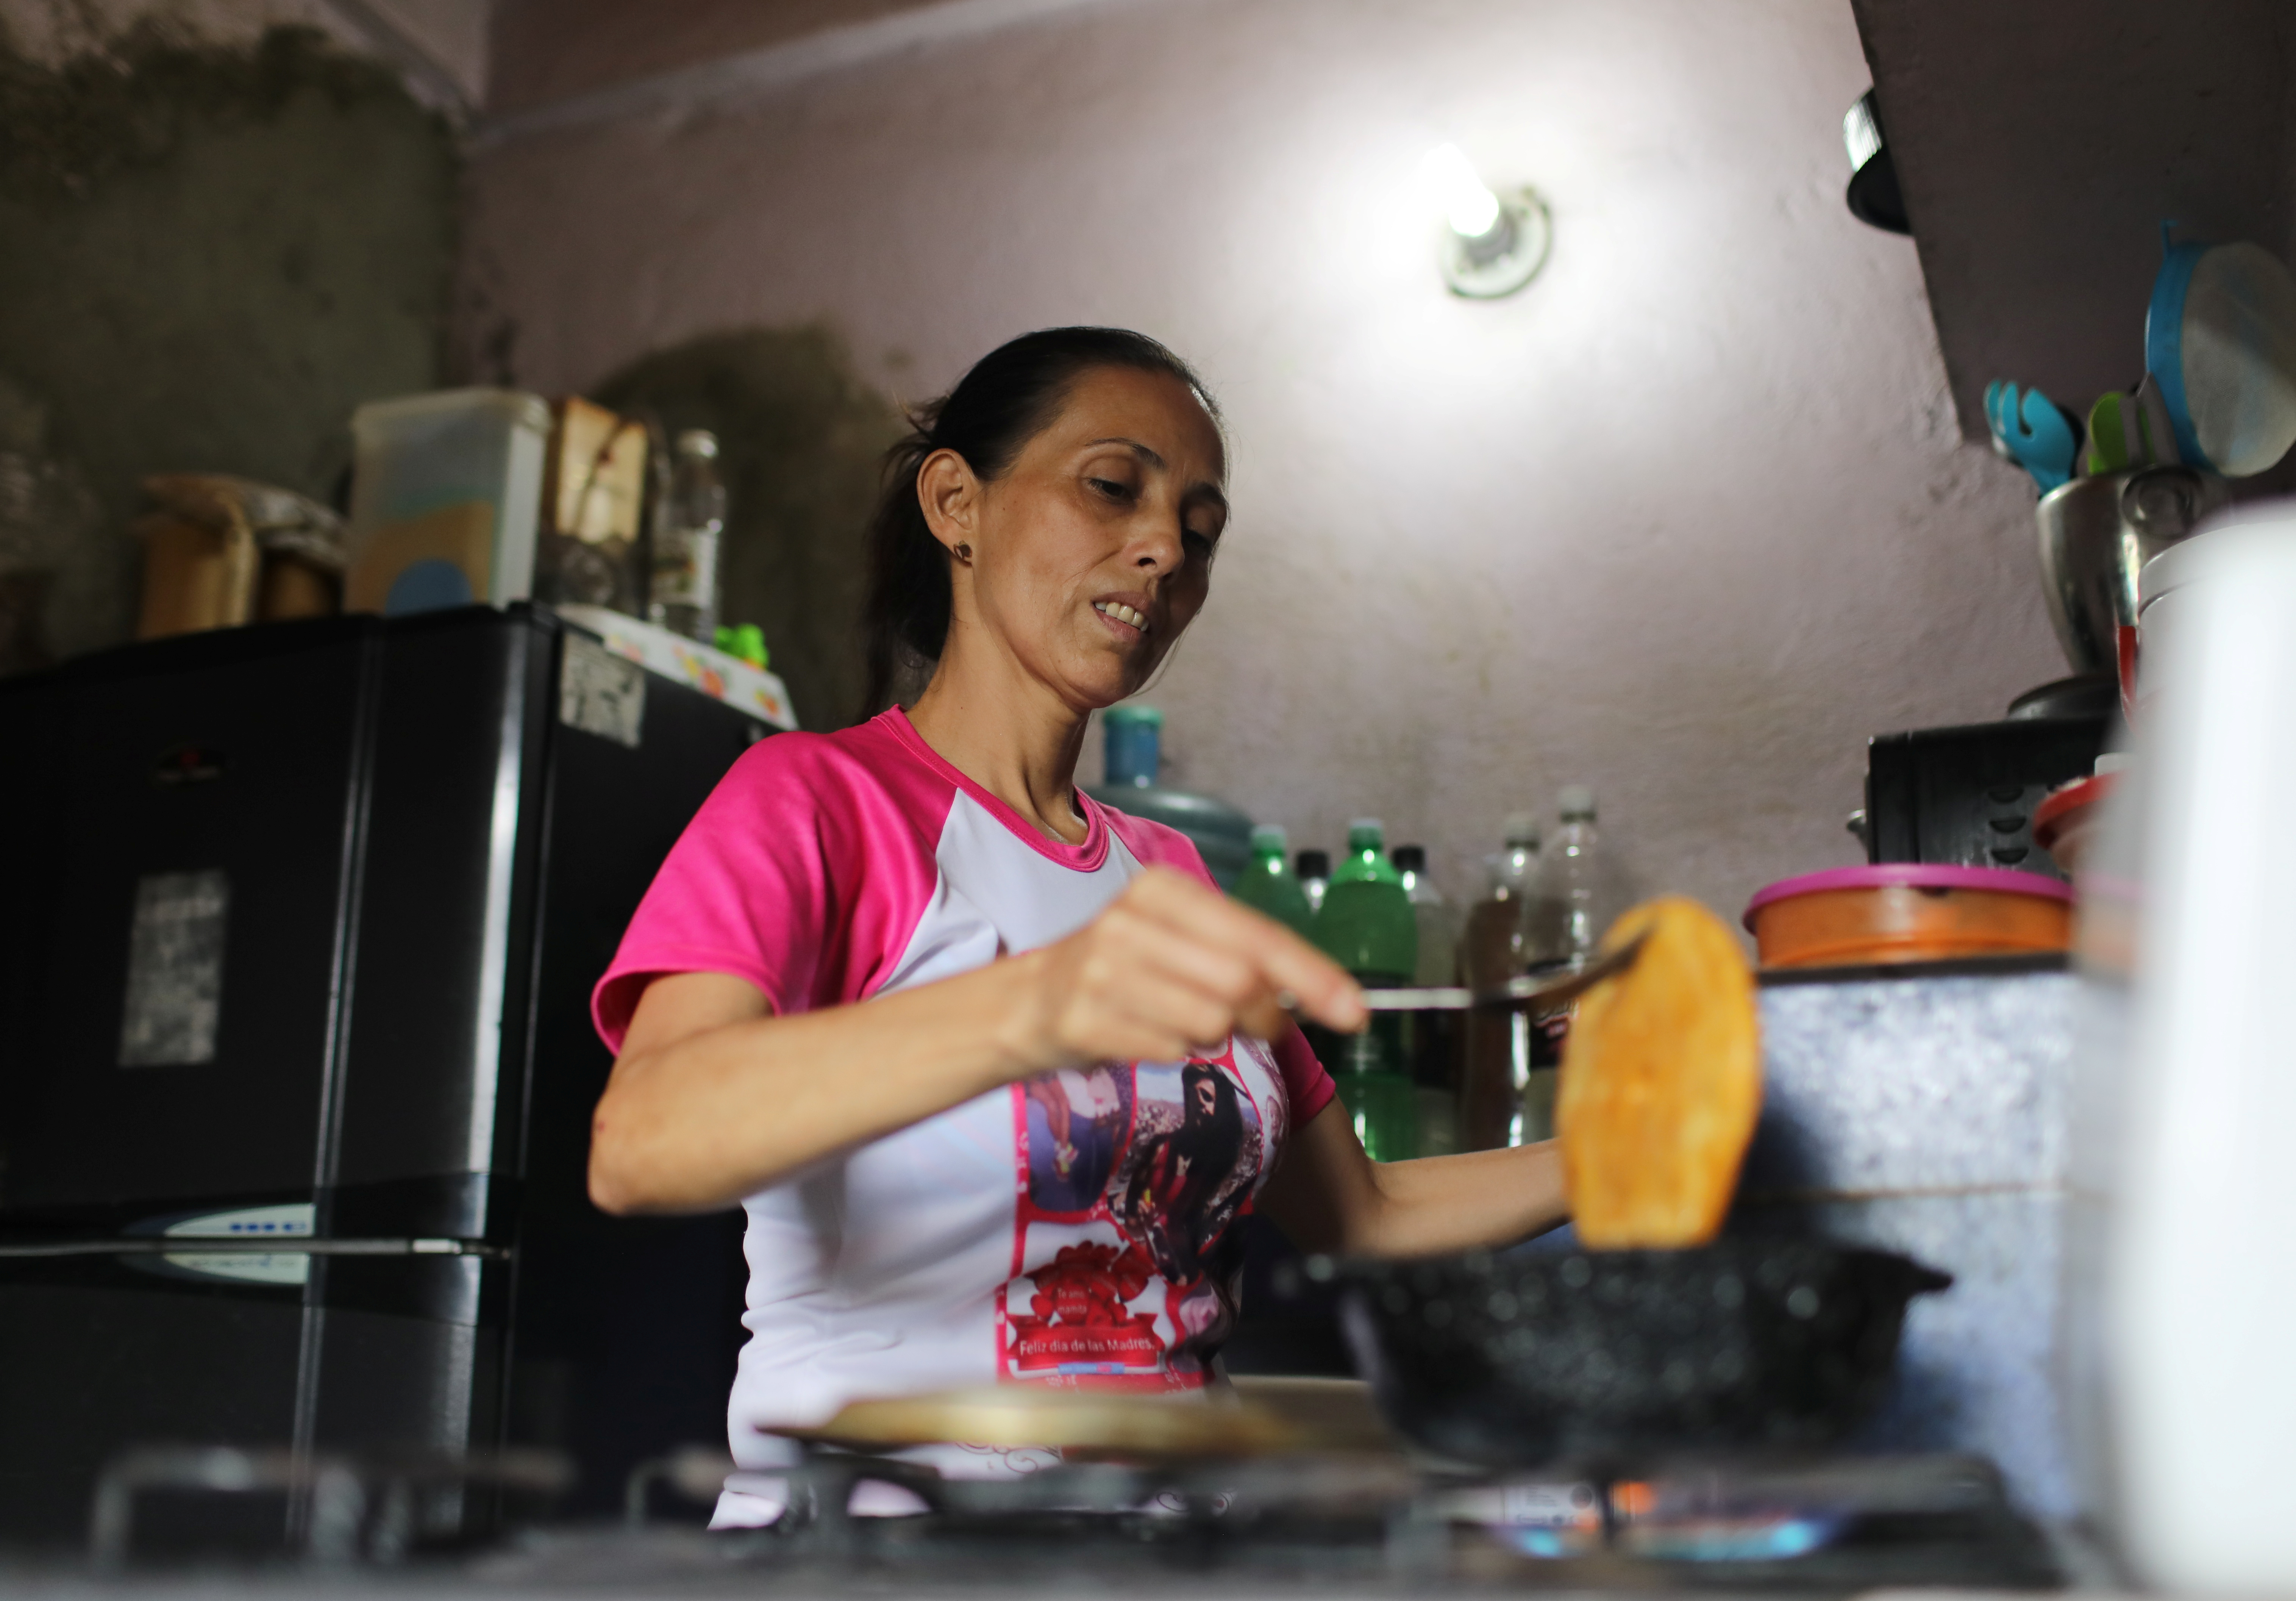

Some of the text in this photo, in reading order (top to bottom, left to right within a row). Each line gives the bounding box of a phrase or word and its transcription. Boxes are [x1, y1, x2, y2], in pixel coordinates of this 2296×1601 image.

[1020, 1340, 1046, 1356] Feliz
[1071, 1338, 1086, 1352] de
[1087, 1338, 1105, 1351] las
[1107, 1337, 1154, 1351] Madres.
